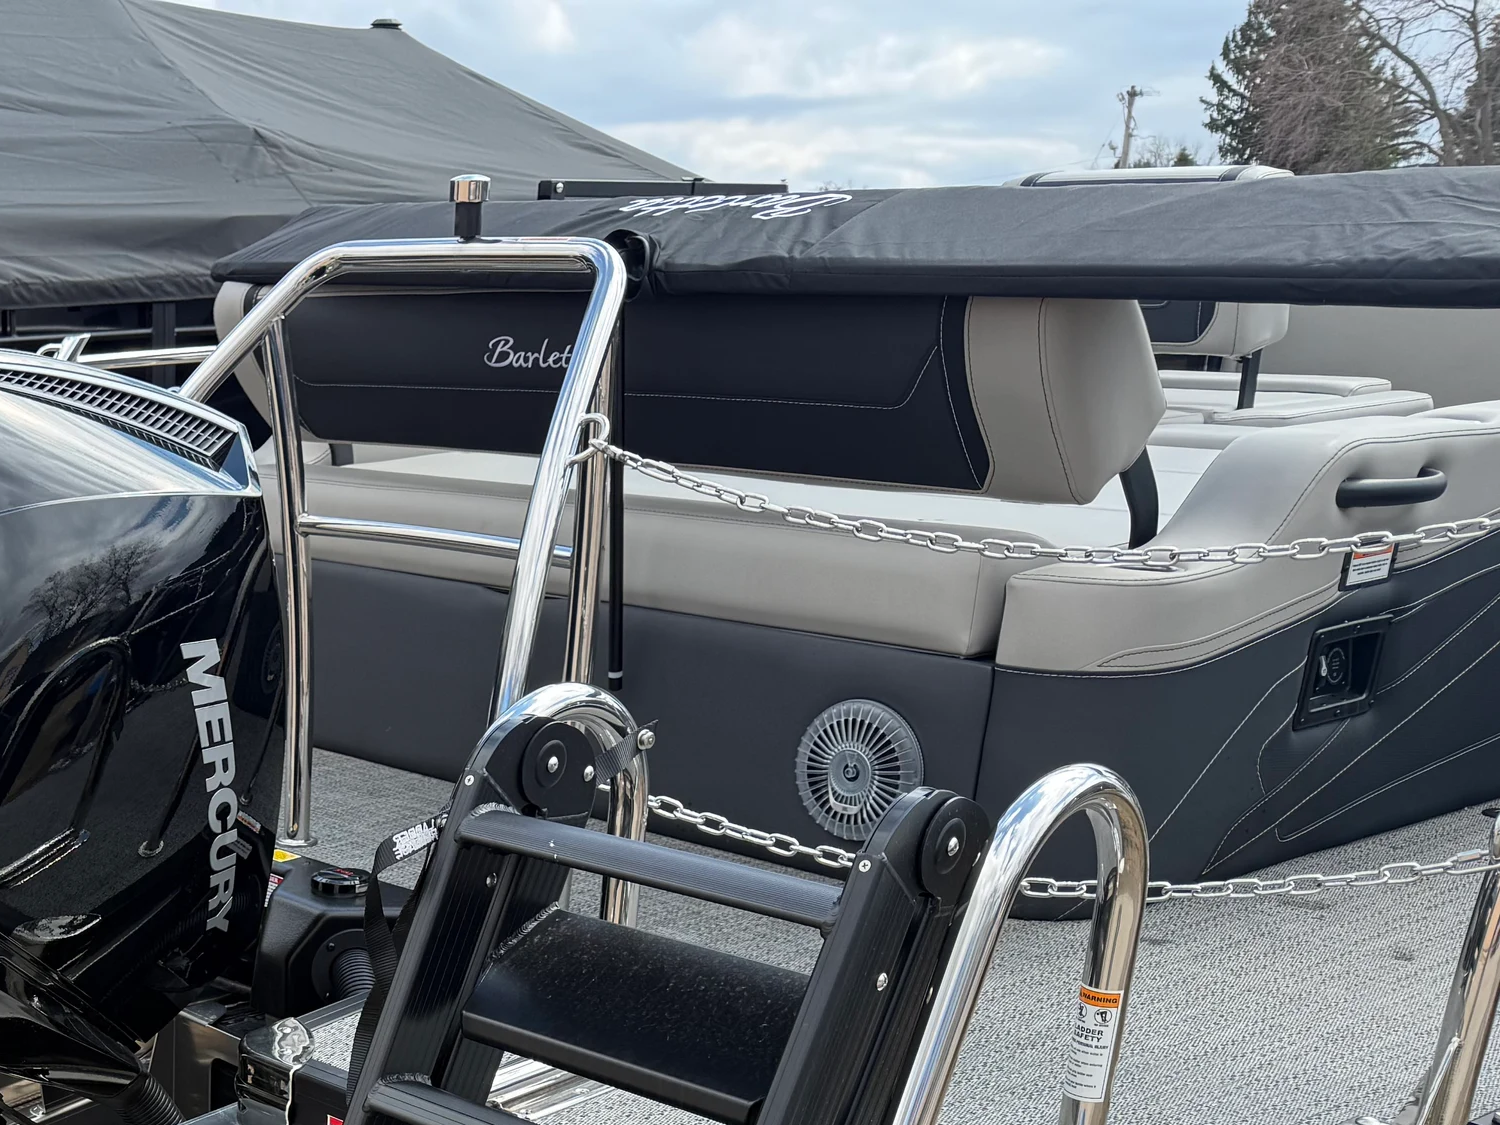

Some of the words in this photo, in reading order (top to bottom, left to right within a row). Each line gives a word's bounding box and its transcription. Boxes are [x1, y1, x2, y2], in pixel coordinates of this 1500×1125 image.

[483, 336, 573, 368] Barlet
[180, 638, 238, 932] MERCURY
[1082, 991, 1118, 1004] WARNING
